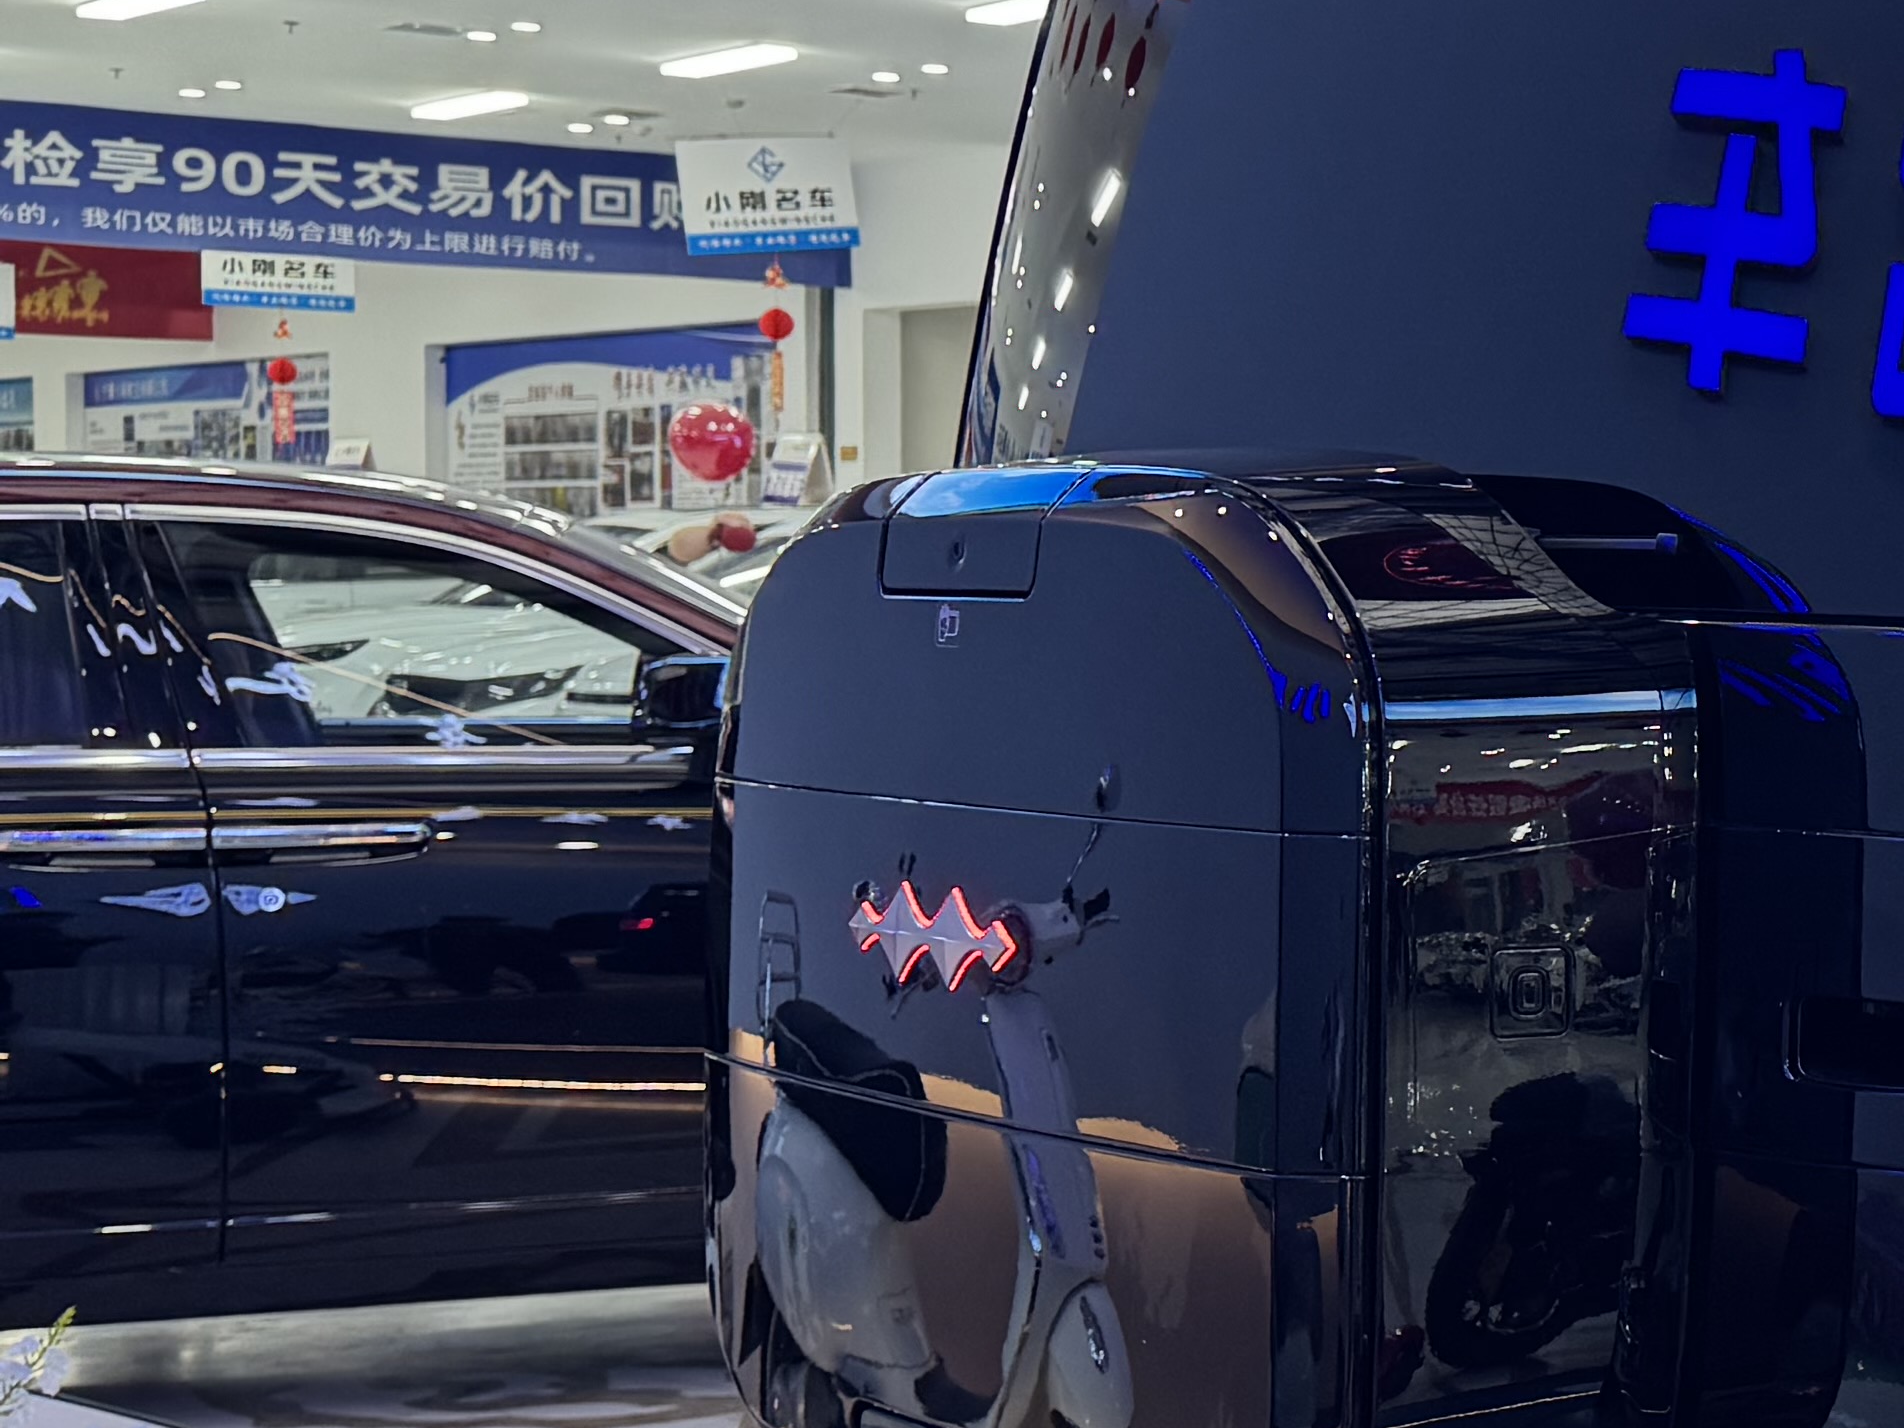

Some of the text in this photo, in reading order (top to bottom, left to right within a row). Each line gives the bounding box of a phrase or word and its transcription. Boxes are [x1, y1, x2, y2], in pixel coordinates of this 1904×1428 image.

[705, 186, 834, 214] 小刚名车
[222, 257, 337, 280] 小刚名车
